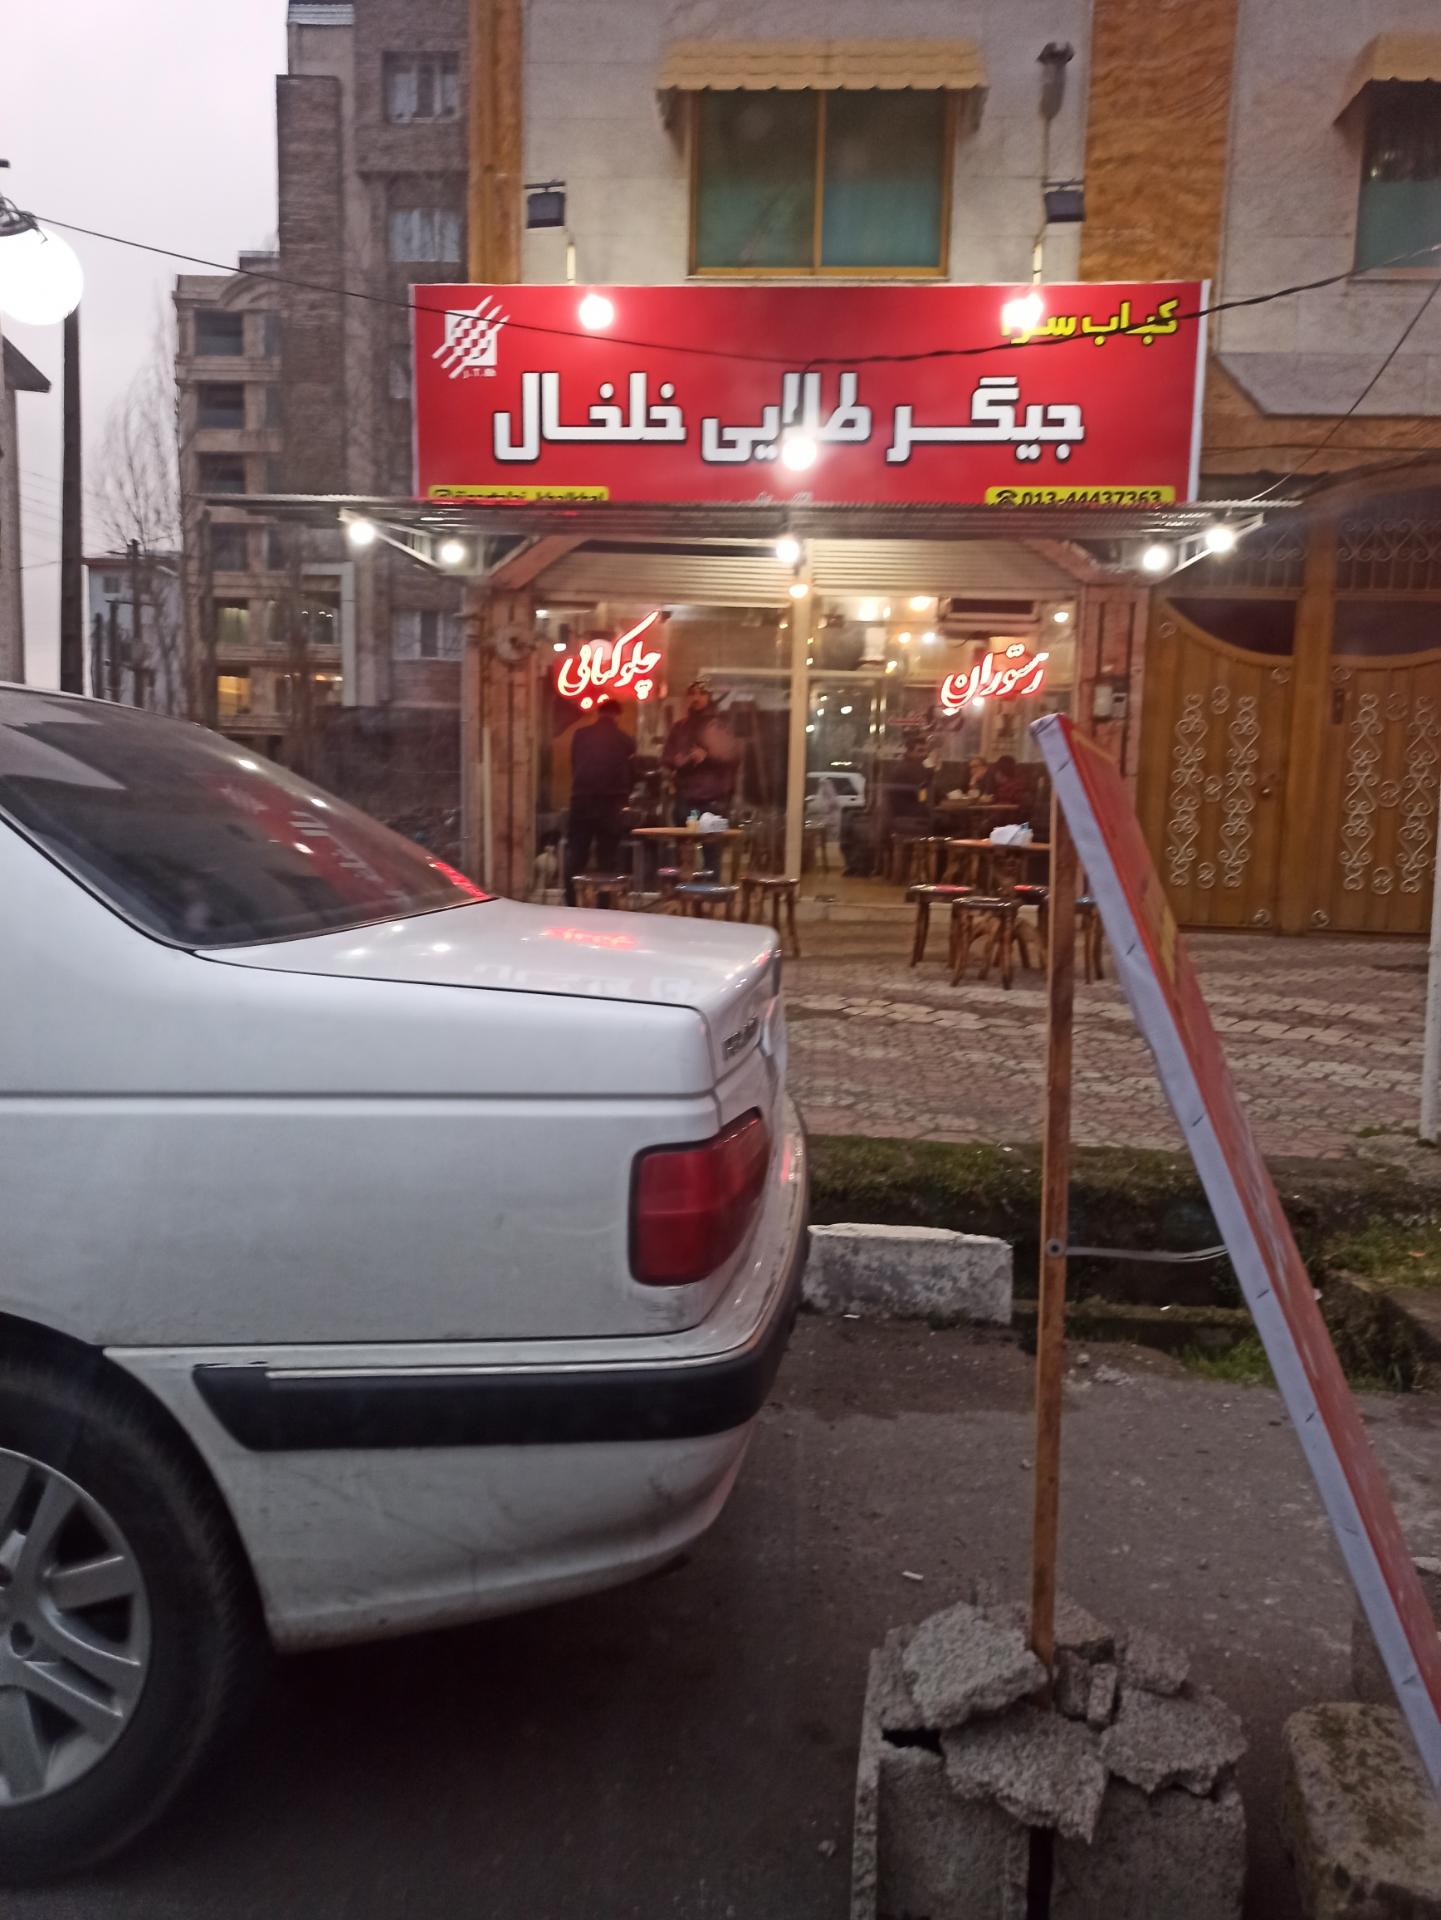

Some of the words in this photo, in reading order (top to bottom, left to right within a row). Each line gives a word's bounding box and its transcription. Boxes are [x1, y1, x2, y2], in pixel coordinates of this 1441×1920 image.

[1001, 301, 1078, 346] سر
[1081, 299, 1179, 346] کباب
[493, 372, 687, 462] خلخال
[702, 372, 872, 463] طلایی
[886, 376, 1085, 463] جیگر
[941, 643, 1049, 708] رستوران
